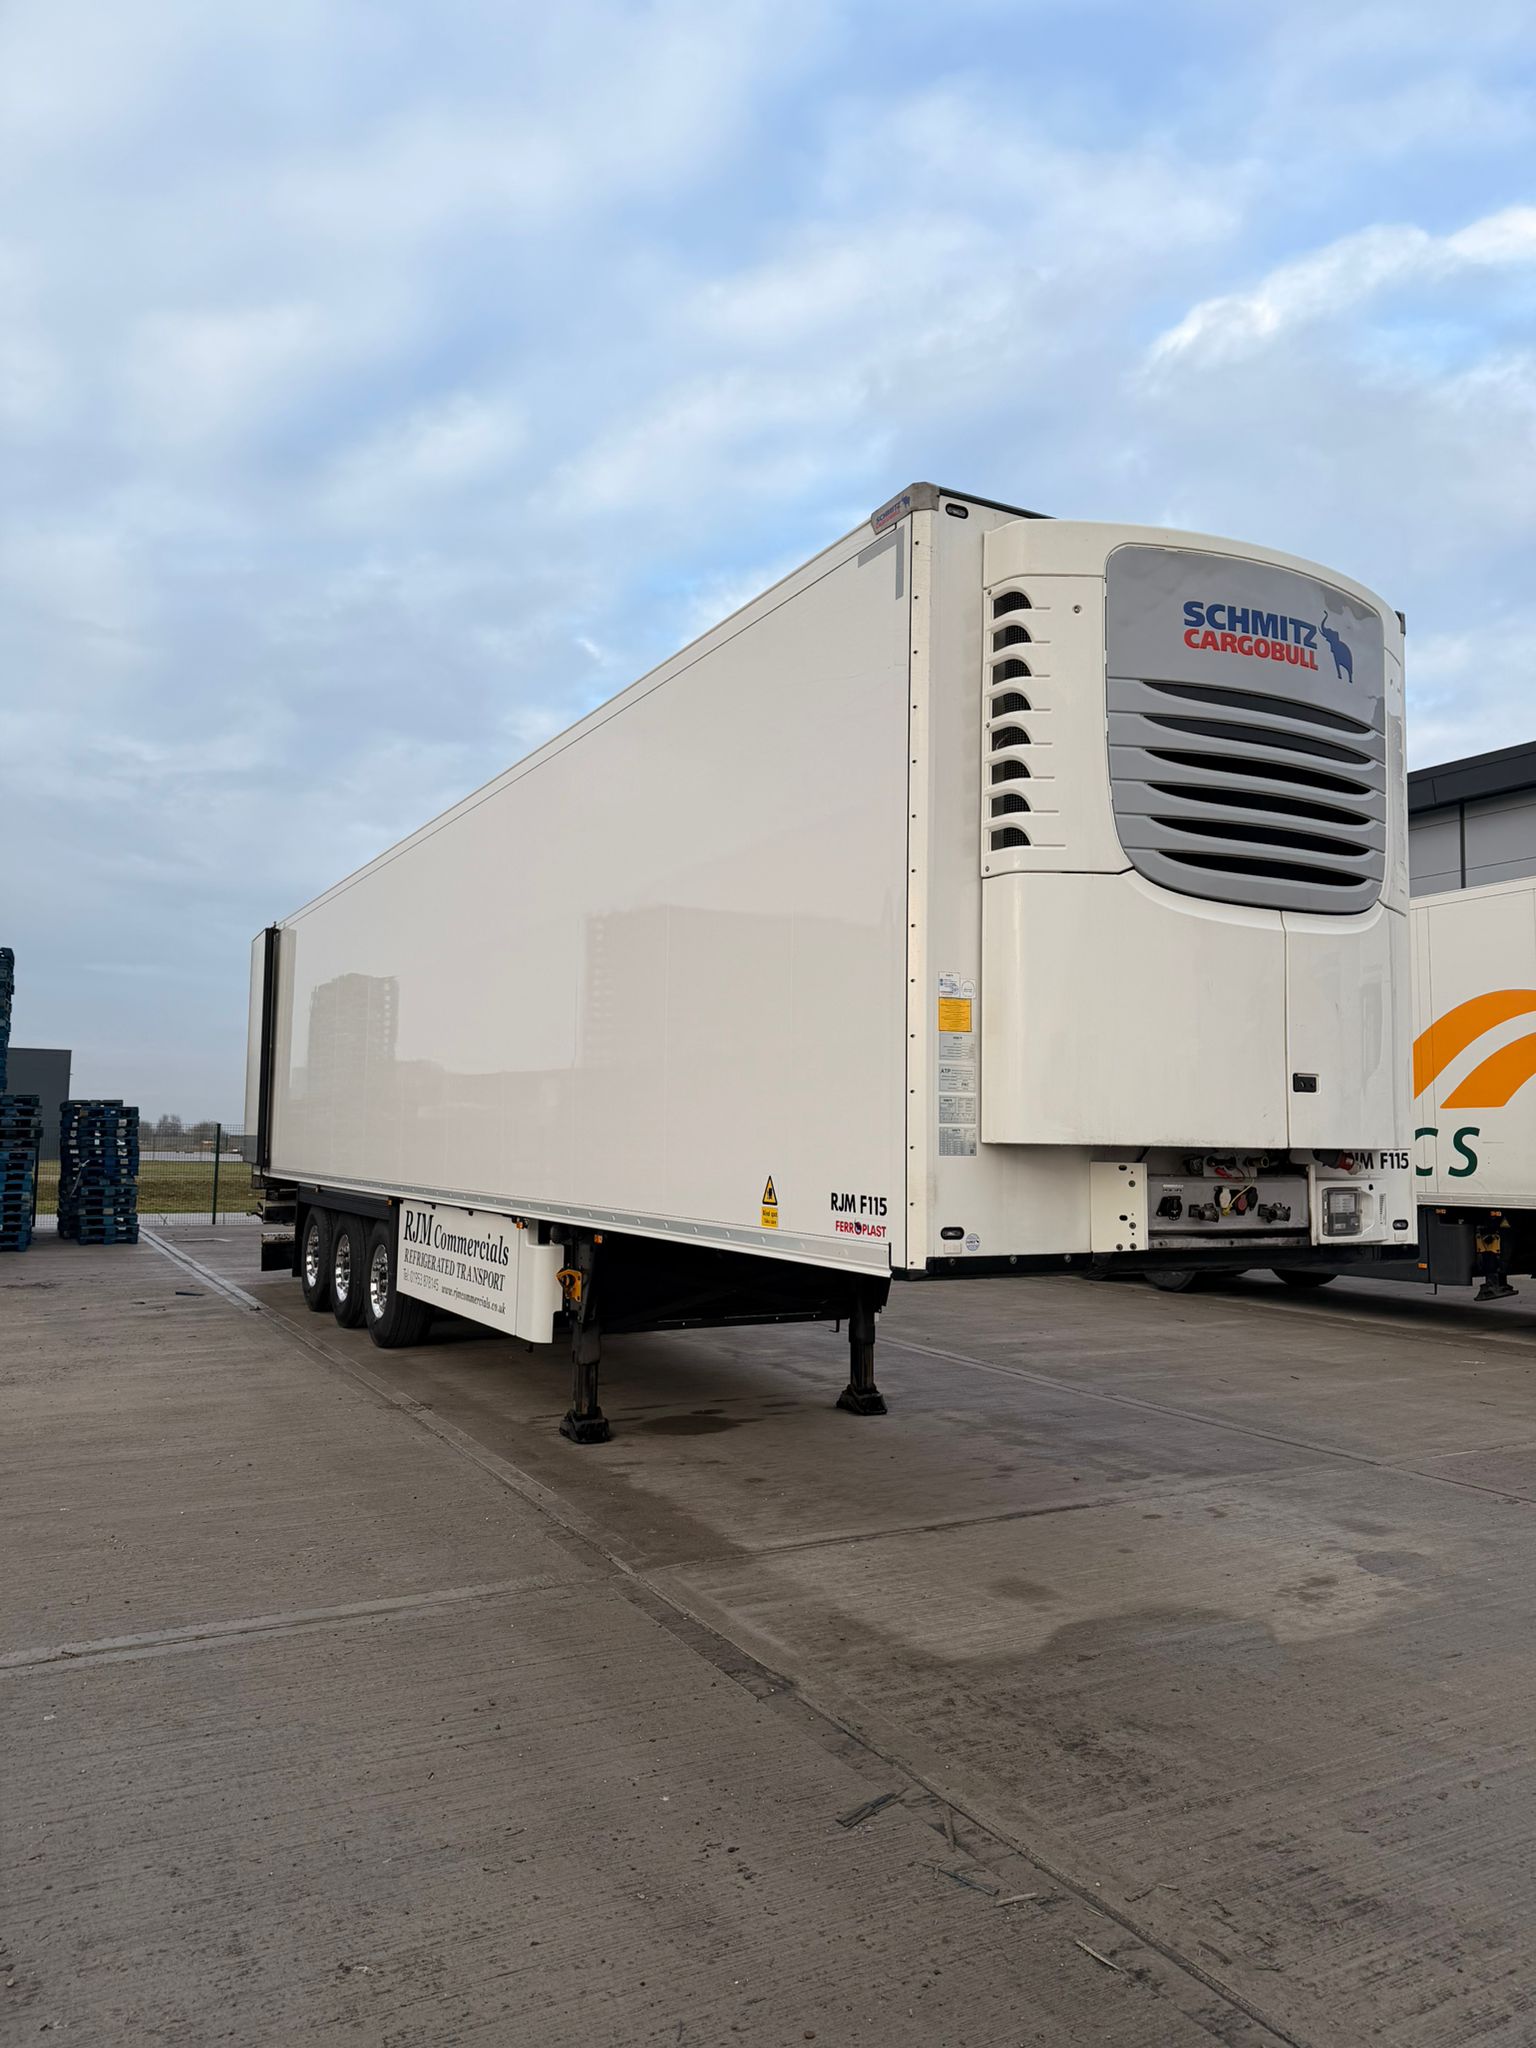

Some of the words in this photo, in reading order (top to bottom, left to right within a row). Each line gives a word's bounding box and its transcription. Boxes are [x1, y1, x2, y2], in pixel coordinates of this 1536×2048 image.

[1183, 600, 1318, 650] SCHMITZ
[1183, 628, 1319, 671] CARGOBULL
[1379, 1152, 1409, 1170] F115
[831, 1192, 856, 1213] RJM
[860, 1195, 888, 1216] F115
[403, 1210, 434, 1247] RJM
[434, 1223, 510, 1266] Commercials
[835, 1220, 887, 1238] FERROPLAST
[404, 1247, 456, 1277] REFRIGERATED
[456, 1262, 506, 1292] TRANSPORT
